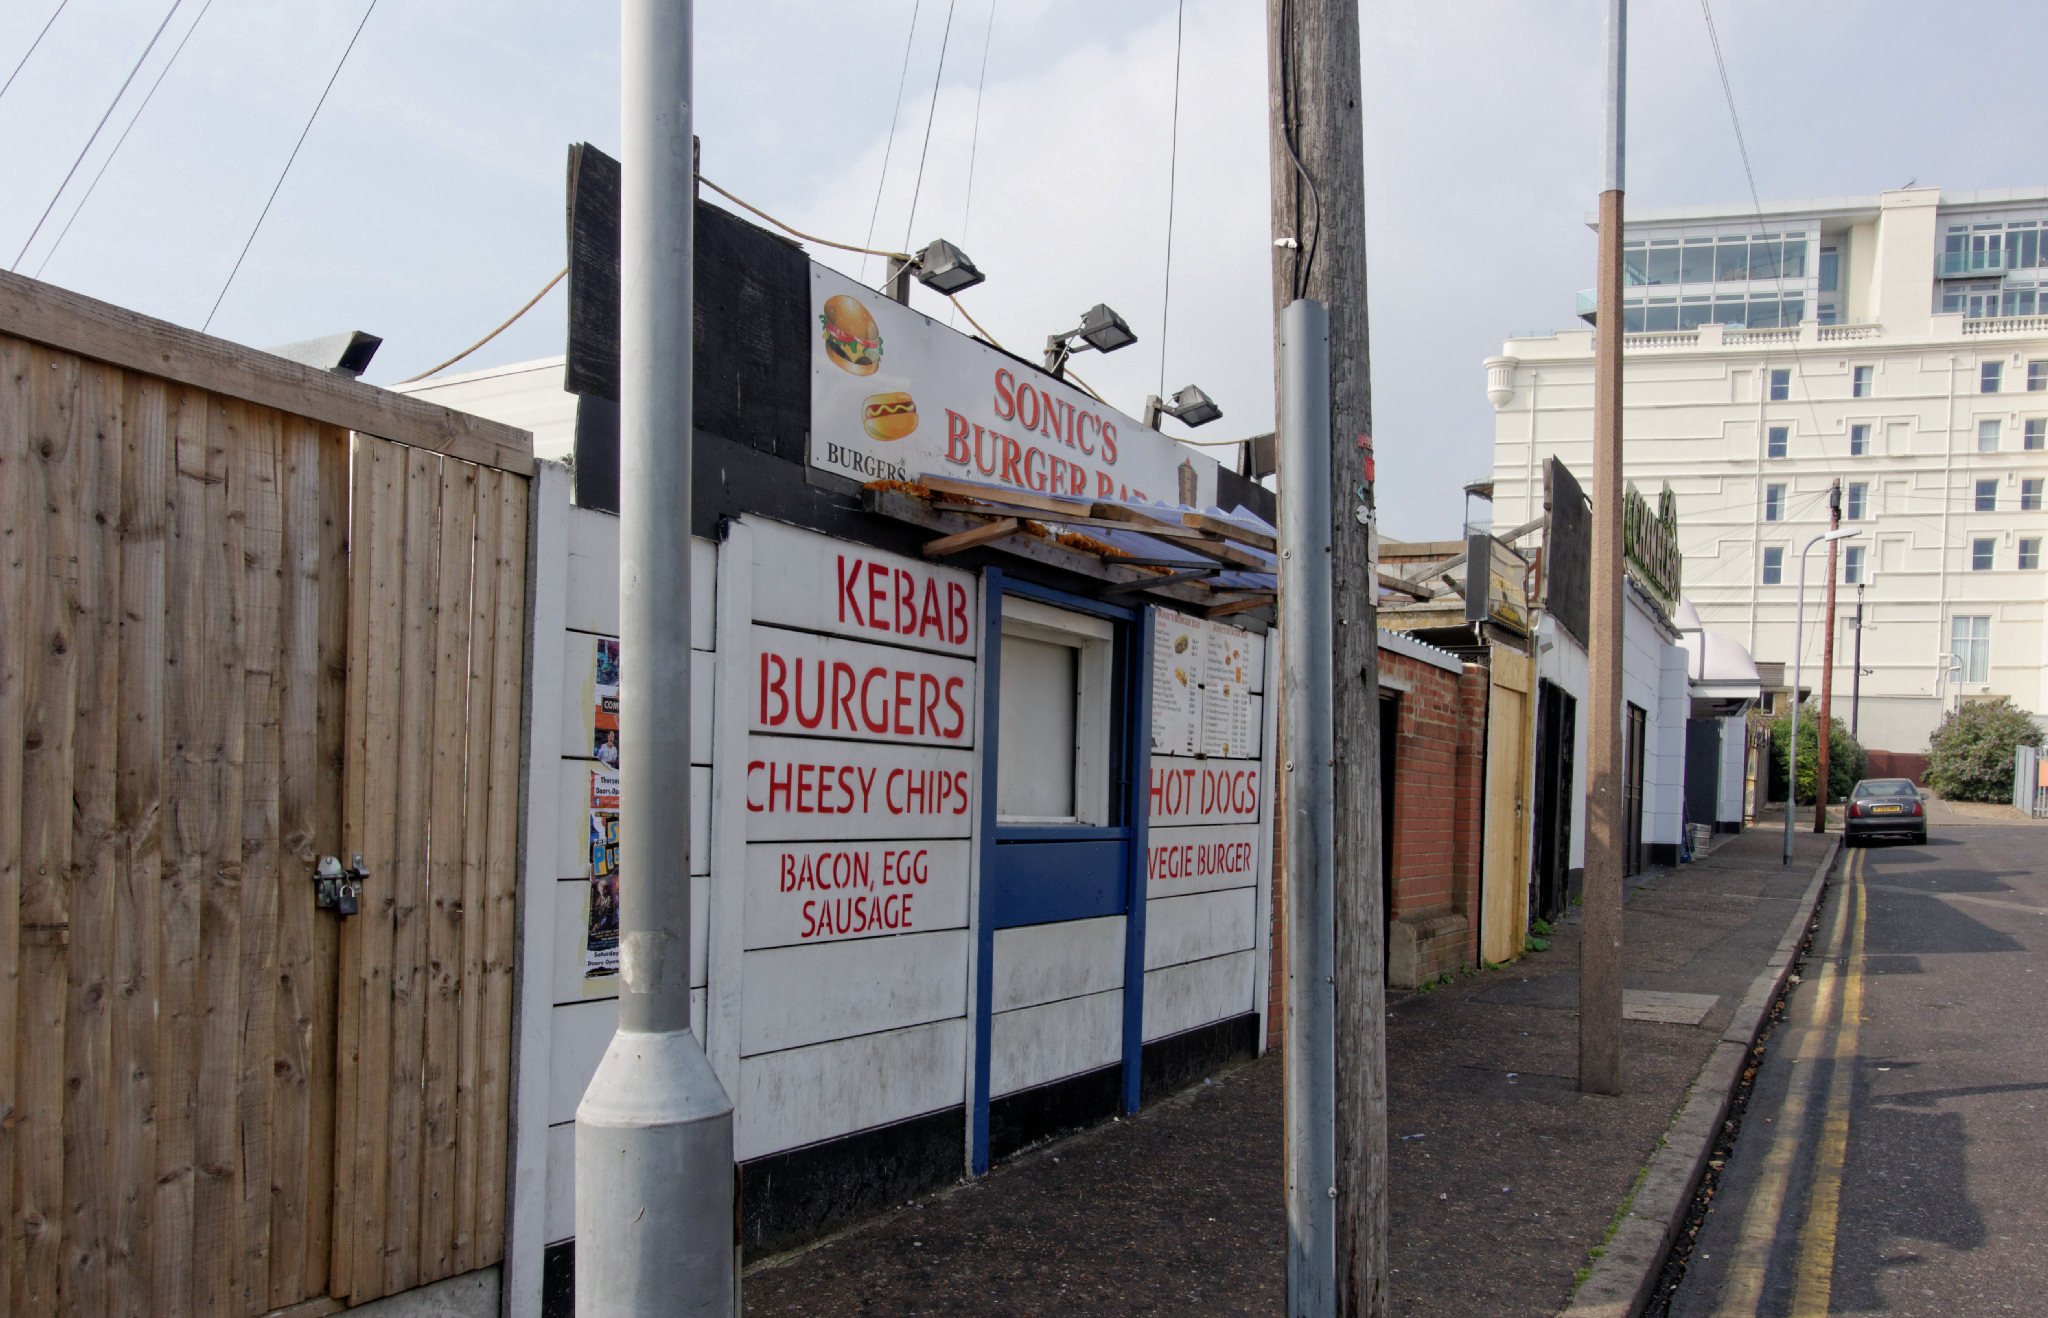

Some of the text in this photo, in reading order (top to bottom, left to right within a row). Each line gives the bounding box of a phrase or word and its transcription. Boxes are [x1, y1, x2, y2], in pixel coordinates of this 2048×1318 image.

[993, 367, 1118, 465] SONIC'S
[826, 441, 906, 483] BURGERS
[944, 407, 1087, 496] BURGER
[837, 554, 969, 646] KEBAB
[604, 700, 619, 710] COM
[760, 652, 964, 739] BURGERS
[747, 760, 968, 815] CHEESY CHIPS
[1149, 768, 1256, 816] HOT DOGS
[780, 849, 928, 893] BACON, EGG
[1147, 842, 1251, 880] VEGIE BURGER
[801, 893, 914, 939] SAUSAGE
